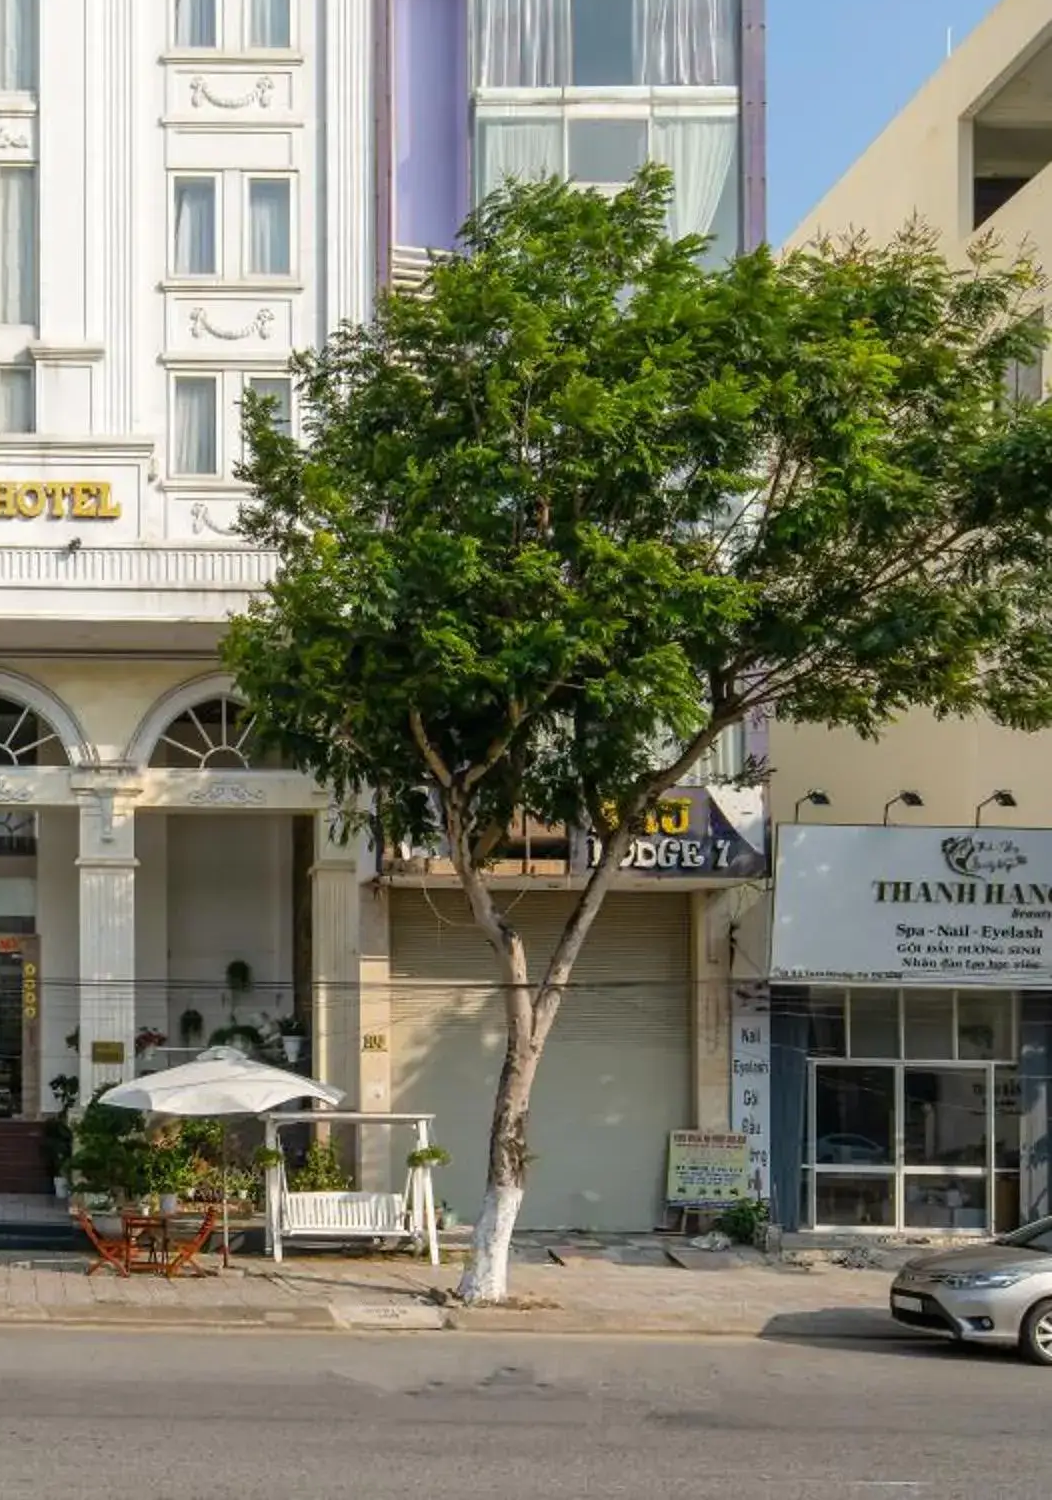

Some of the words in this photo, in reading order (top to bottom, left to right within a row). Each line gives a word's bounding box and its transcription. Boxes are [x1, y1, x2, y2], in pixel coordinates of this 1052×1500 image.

[872, 881, 976, 904] THANH
[985, 883, 1052, 905] HAN
[896, 924, 925, 938] Spa
[937, 925, 970, 937] Nail
[982, 925, 1044, 940] Eyelash
[741, 1028, 761, 1043] Nail
[733, 1059, 769, 1078] Eyelash
